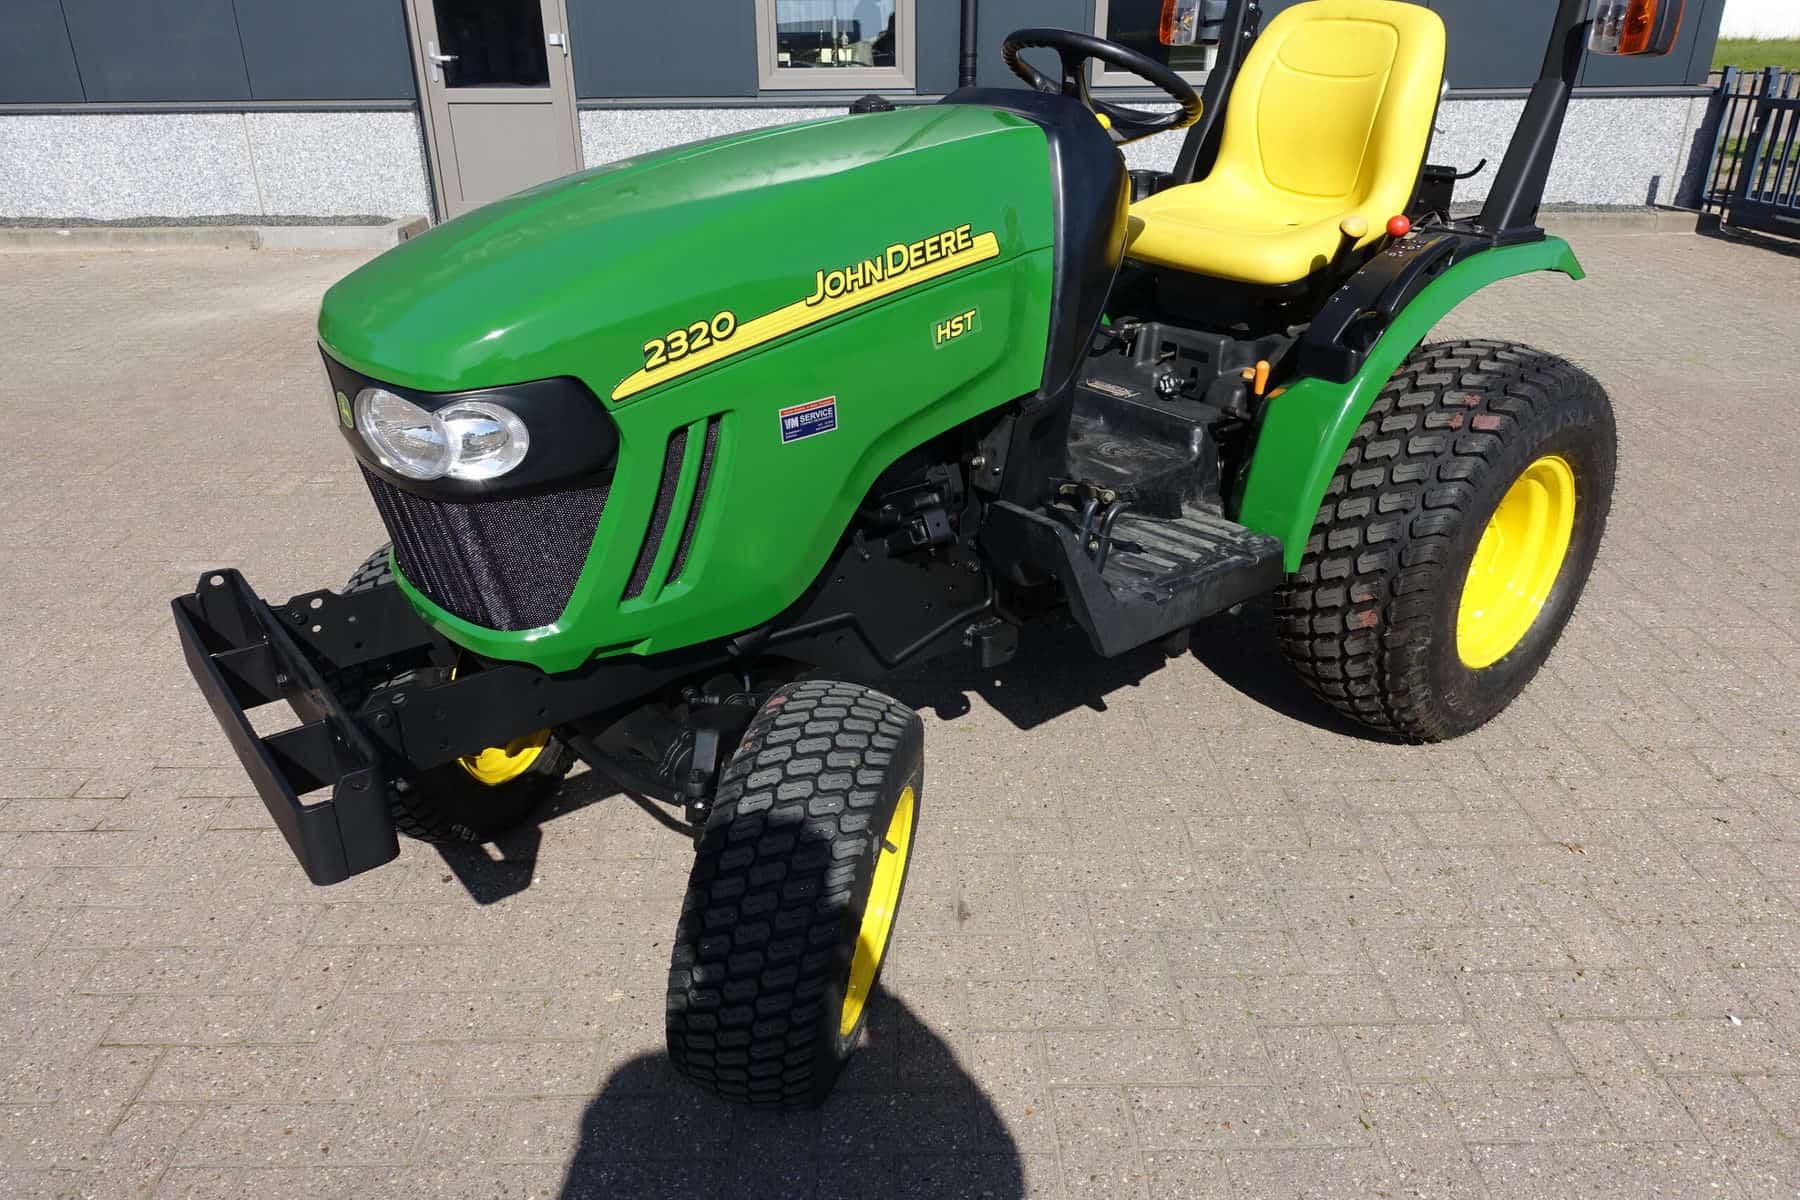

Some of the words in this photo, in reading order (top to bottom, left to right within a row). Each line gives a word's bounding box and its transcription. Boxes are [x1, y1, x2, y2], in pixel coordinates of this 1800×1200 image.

[806, 255, 884, 306] JOHN
[885, 223, 974, 279] DEERE
[643, 310, 737, 372] 2320
[935, 309, 977, 345] HST
[799, 407, 833, 423] SERVICE
